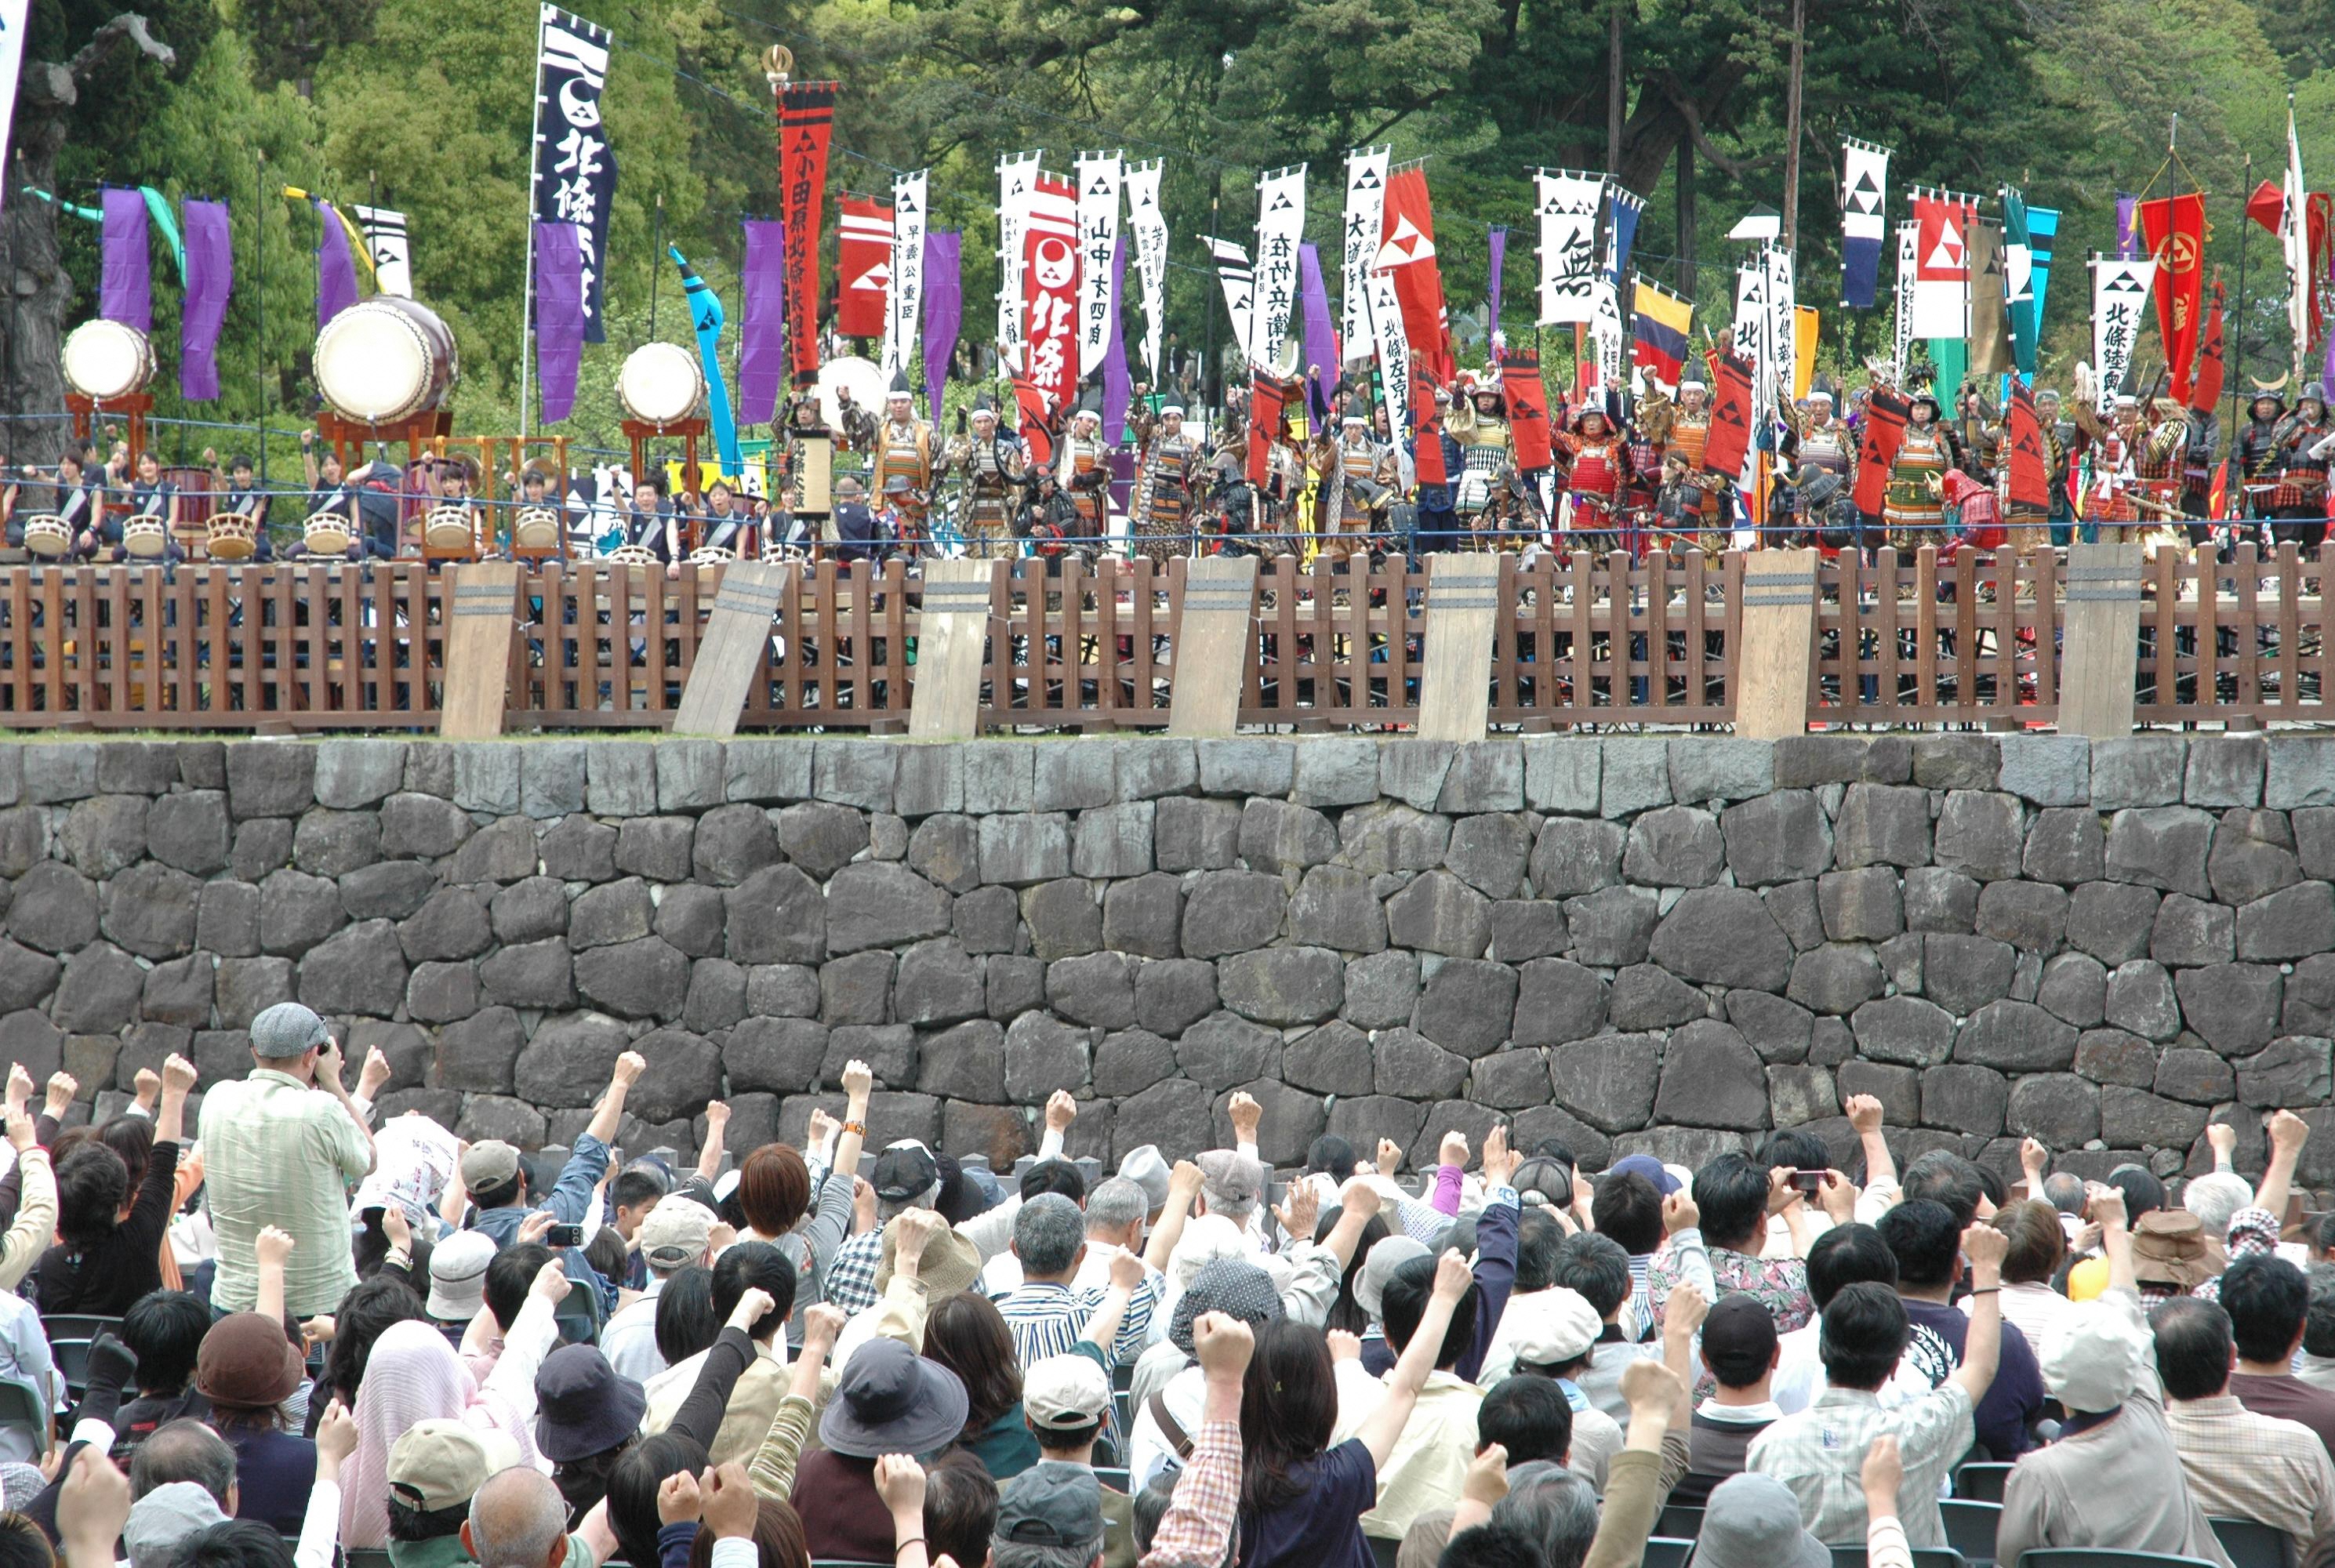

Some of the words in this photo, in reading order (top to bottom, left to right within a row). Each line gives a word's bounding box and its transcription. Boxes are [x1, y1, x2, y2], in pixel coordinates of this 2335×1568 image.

[901, 224, 919, 319] 早雲公重臣
[1552, 225, 1592, 304] 無
